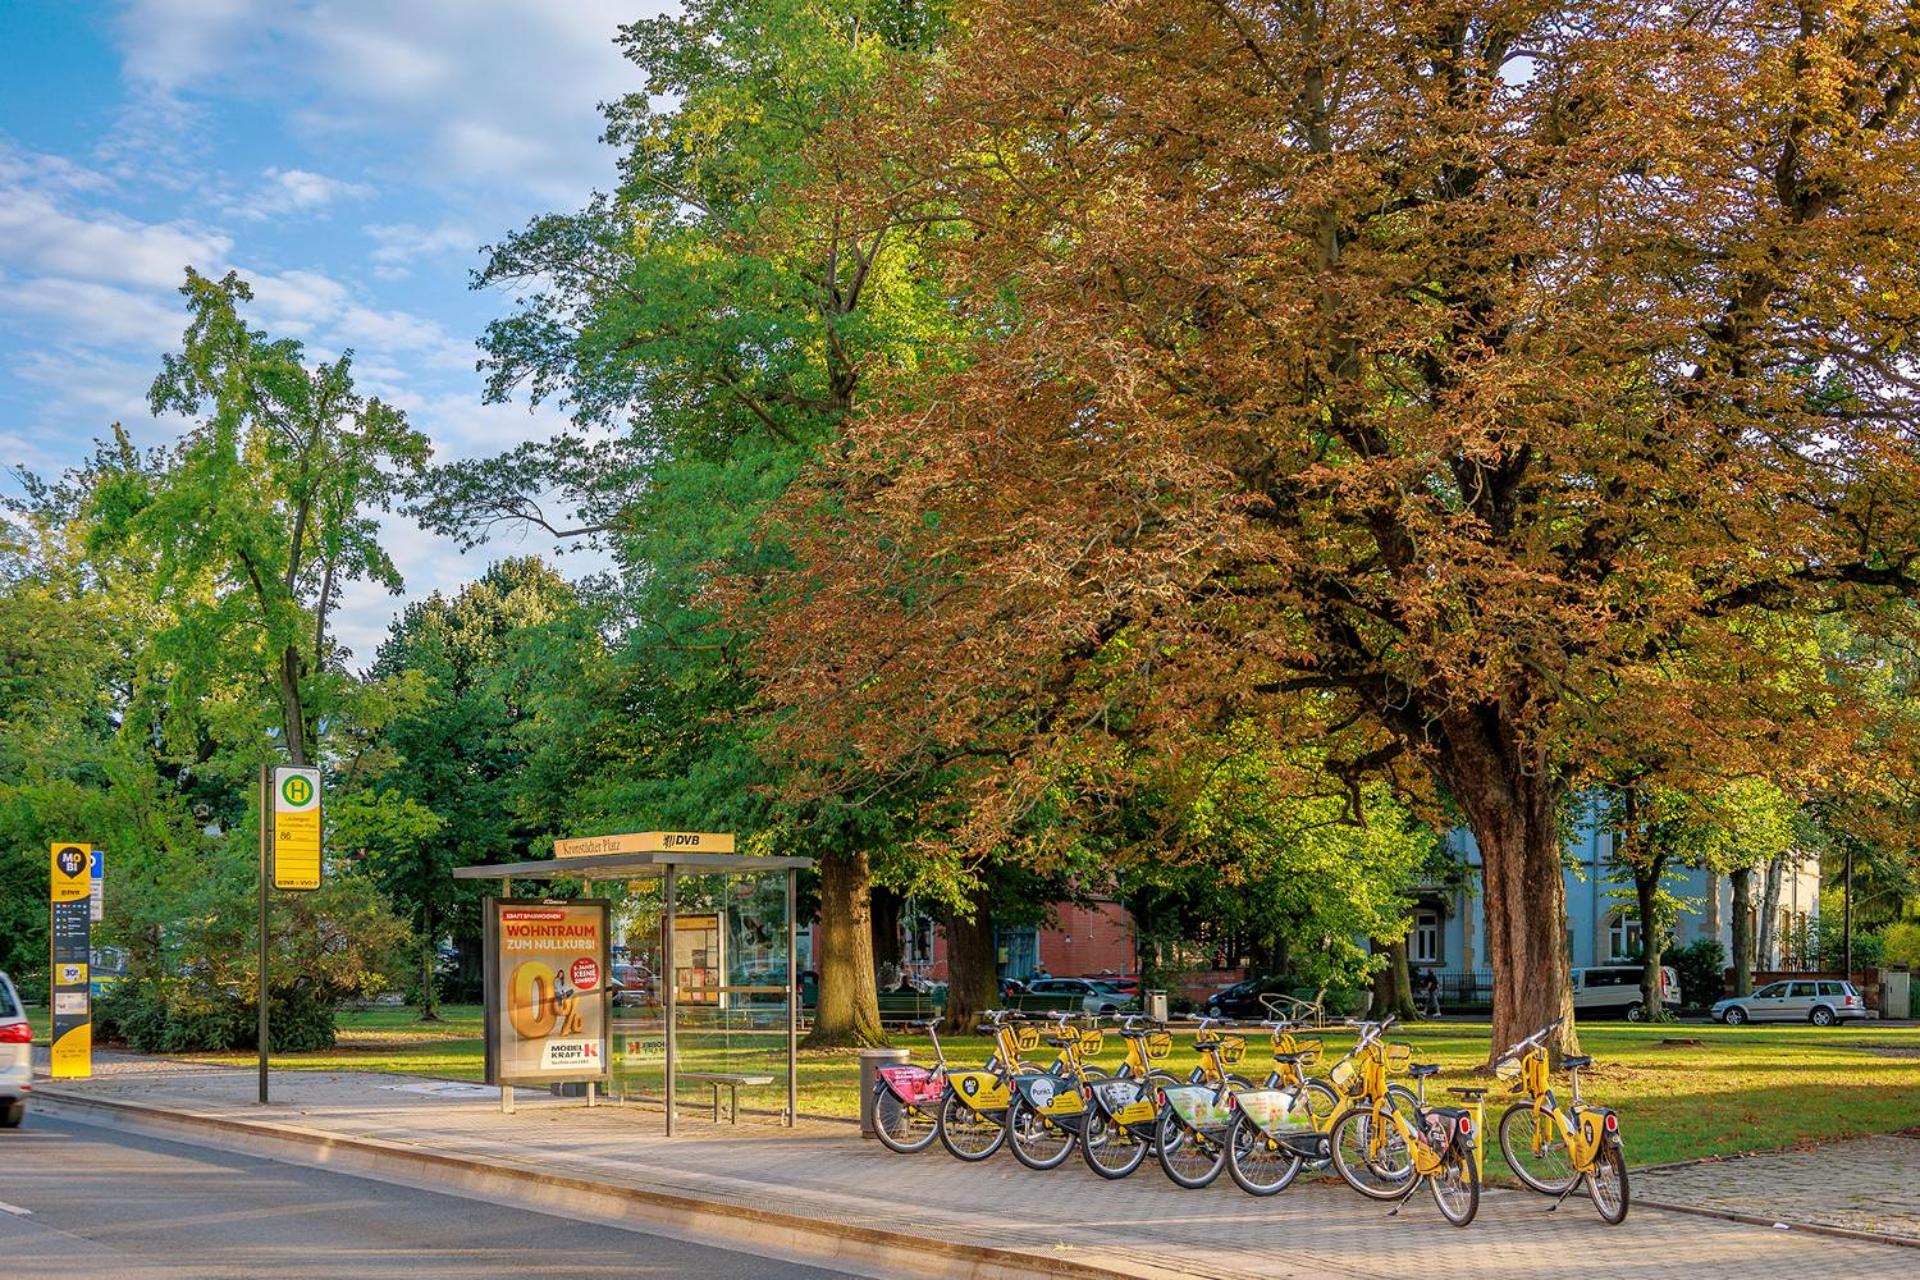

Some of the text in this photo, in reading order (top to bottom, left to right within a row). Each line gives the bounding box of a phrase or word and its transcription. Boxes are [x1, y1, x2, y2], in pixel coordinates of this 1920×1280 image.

[291, 781, 304, 800] H
[280, 832, 291, 840] 86
[675, 834, 700, 846] DVB
[62, 853, 81, 863] MO
[66, 862, 77, 871] BI
[507, 925, 595, 937] WOHNTRAUM
[507, 939, 595, 950] ZUM NULLKURS!
[508, 960, 583, 1039] 0%
